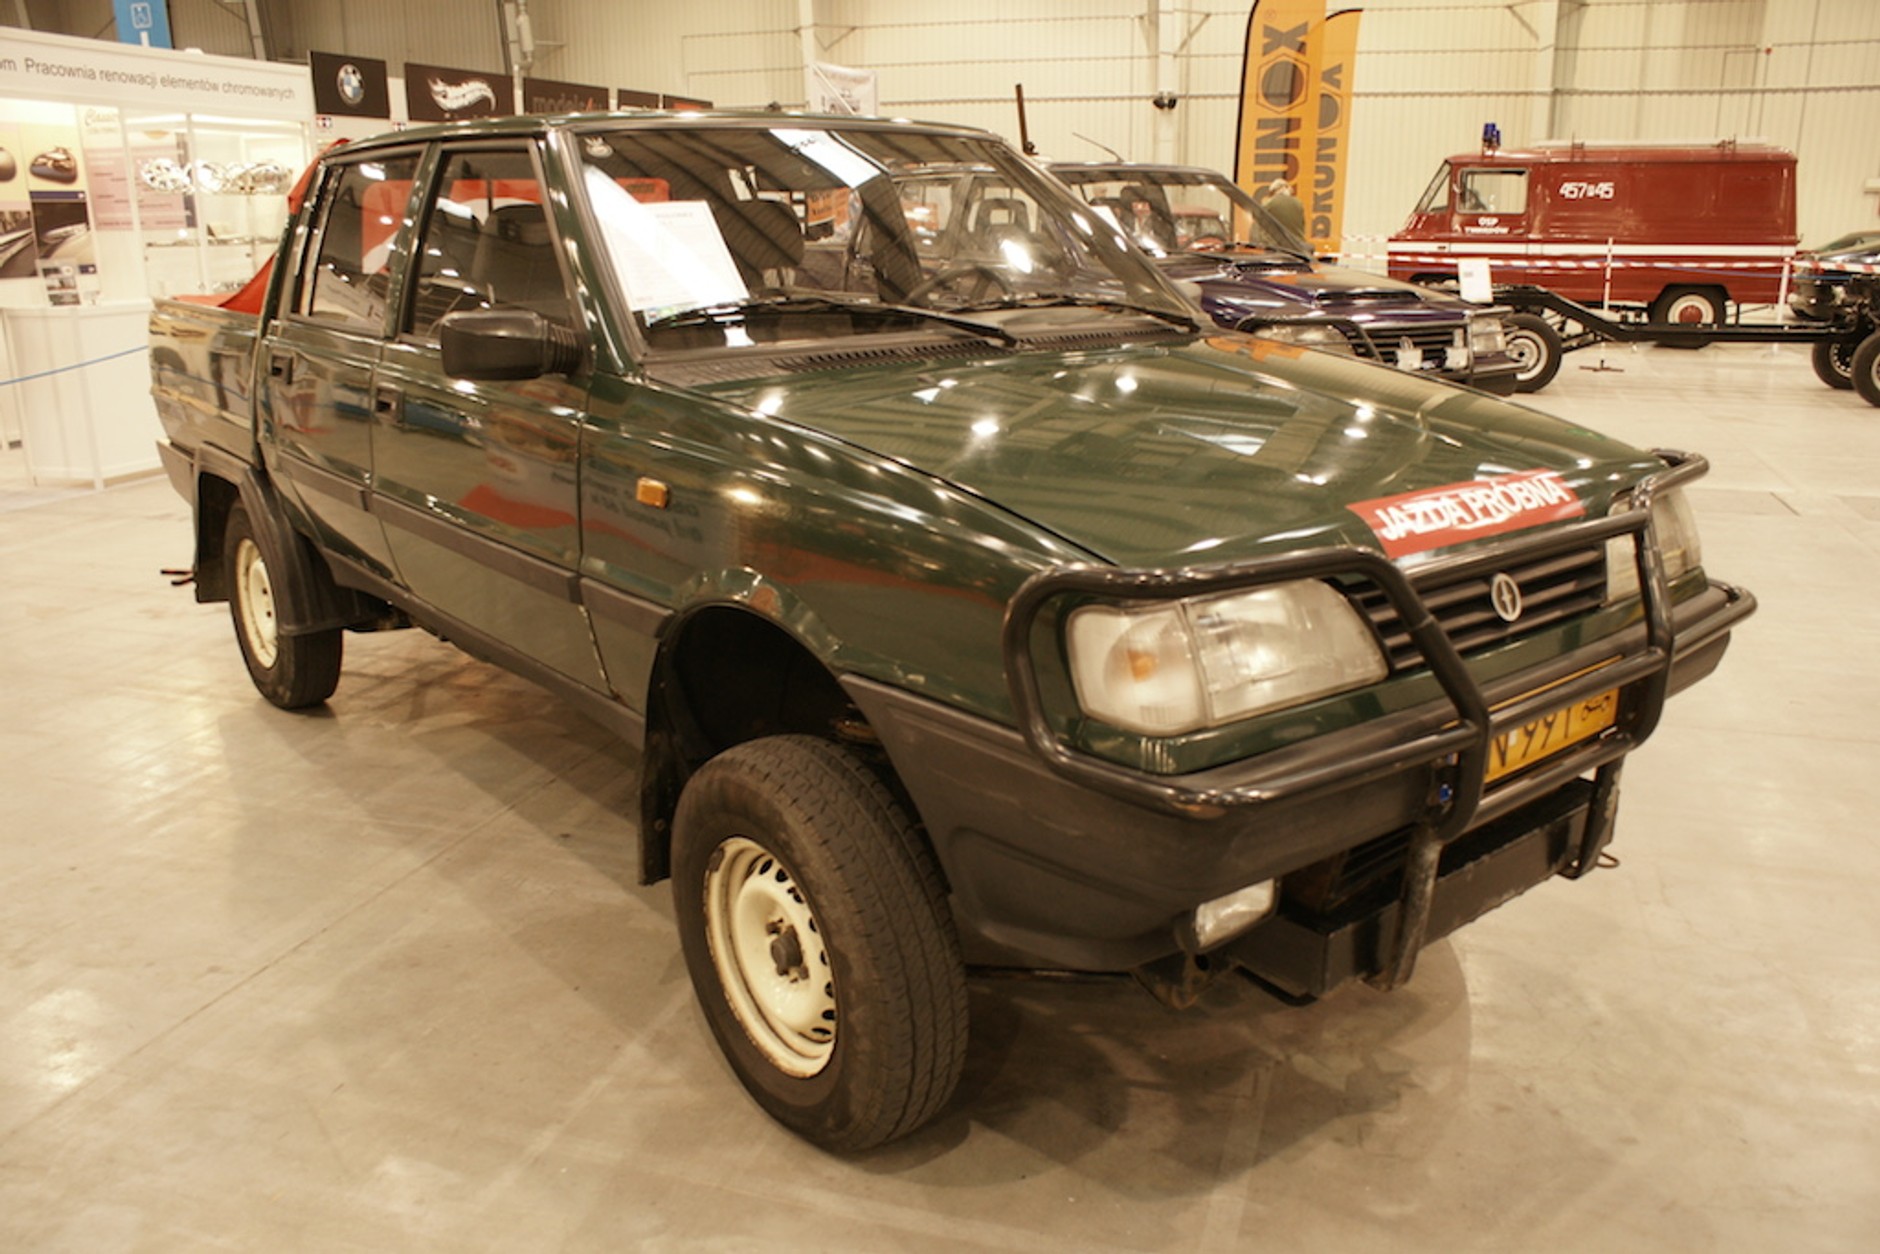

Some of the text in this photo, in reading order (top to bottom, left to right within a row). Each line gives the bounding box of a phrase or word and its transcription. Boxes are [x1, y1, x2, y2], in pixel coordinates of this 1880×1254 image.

[0, 57, 296, 101] m Pracownia renowacji elementów chromowanych
[1253, 21, 1309, 202] RUNOX
[1375, 476, 1571, 541] JAZDA PRÓBNA
